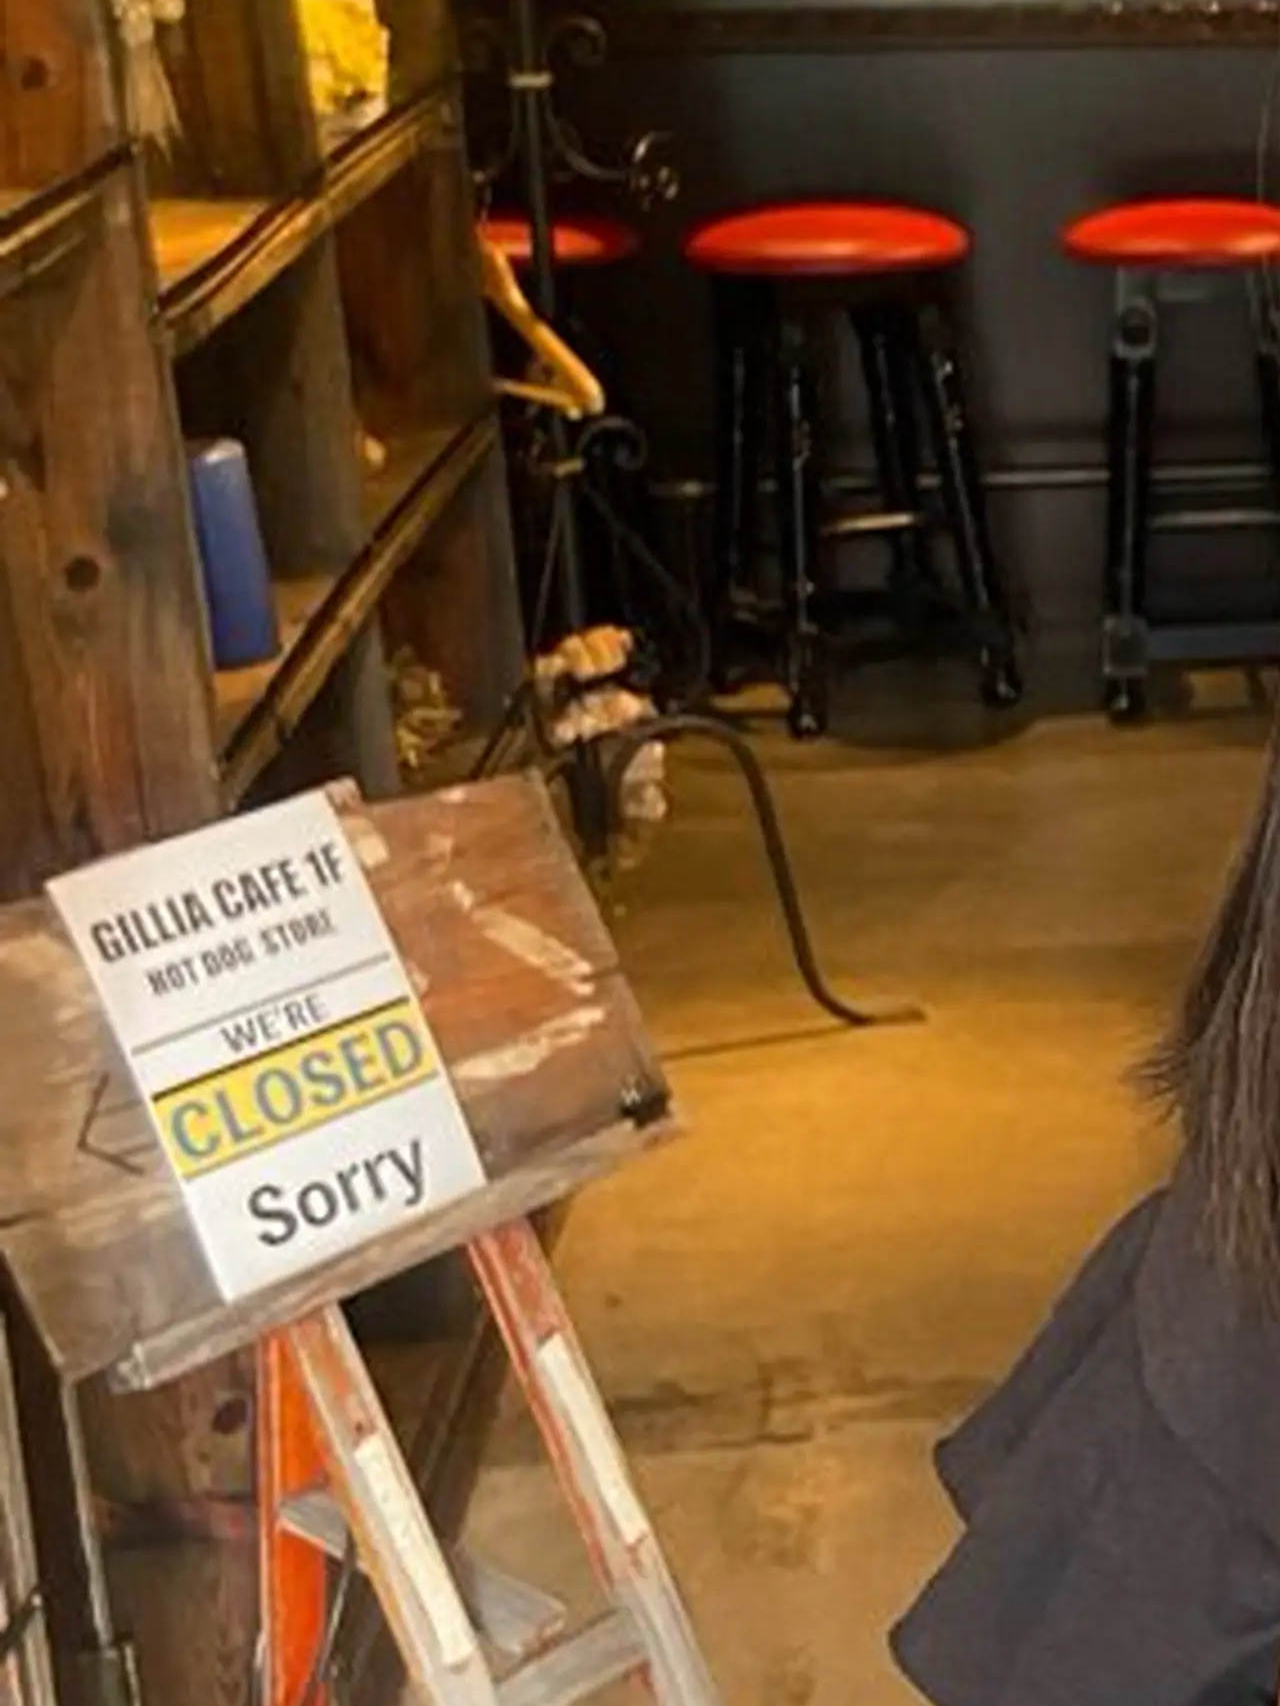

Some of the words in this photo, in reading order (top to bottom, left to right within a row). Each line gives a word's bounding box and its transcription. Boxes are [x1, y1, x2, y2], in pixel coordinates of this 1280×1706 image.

[90, 889, 215, 963] GILLIA
[211, 858, 305, 920] CAFE
[304, 843, 345, 888] 1F
[146, 958, 199, 996] HOT
[201, 938, 255, 979] DOG
[259, 907, 337, 955] STORE
[220, 994, 330, 1053] WE'RE
[171, 1020, 424, 1160] CLOSED
[249, 1137, 425, 1247] Sorry
